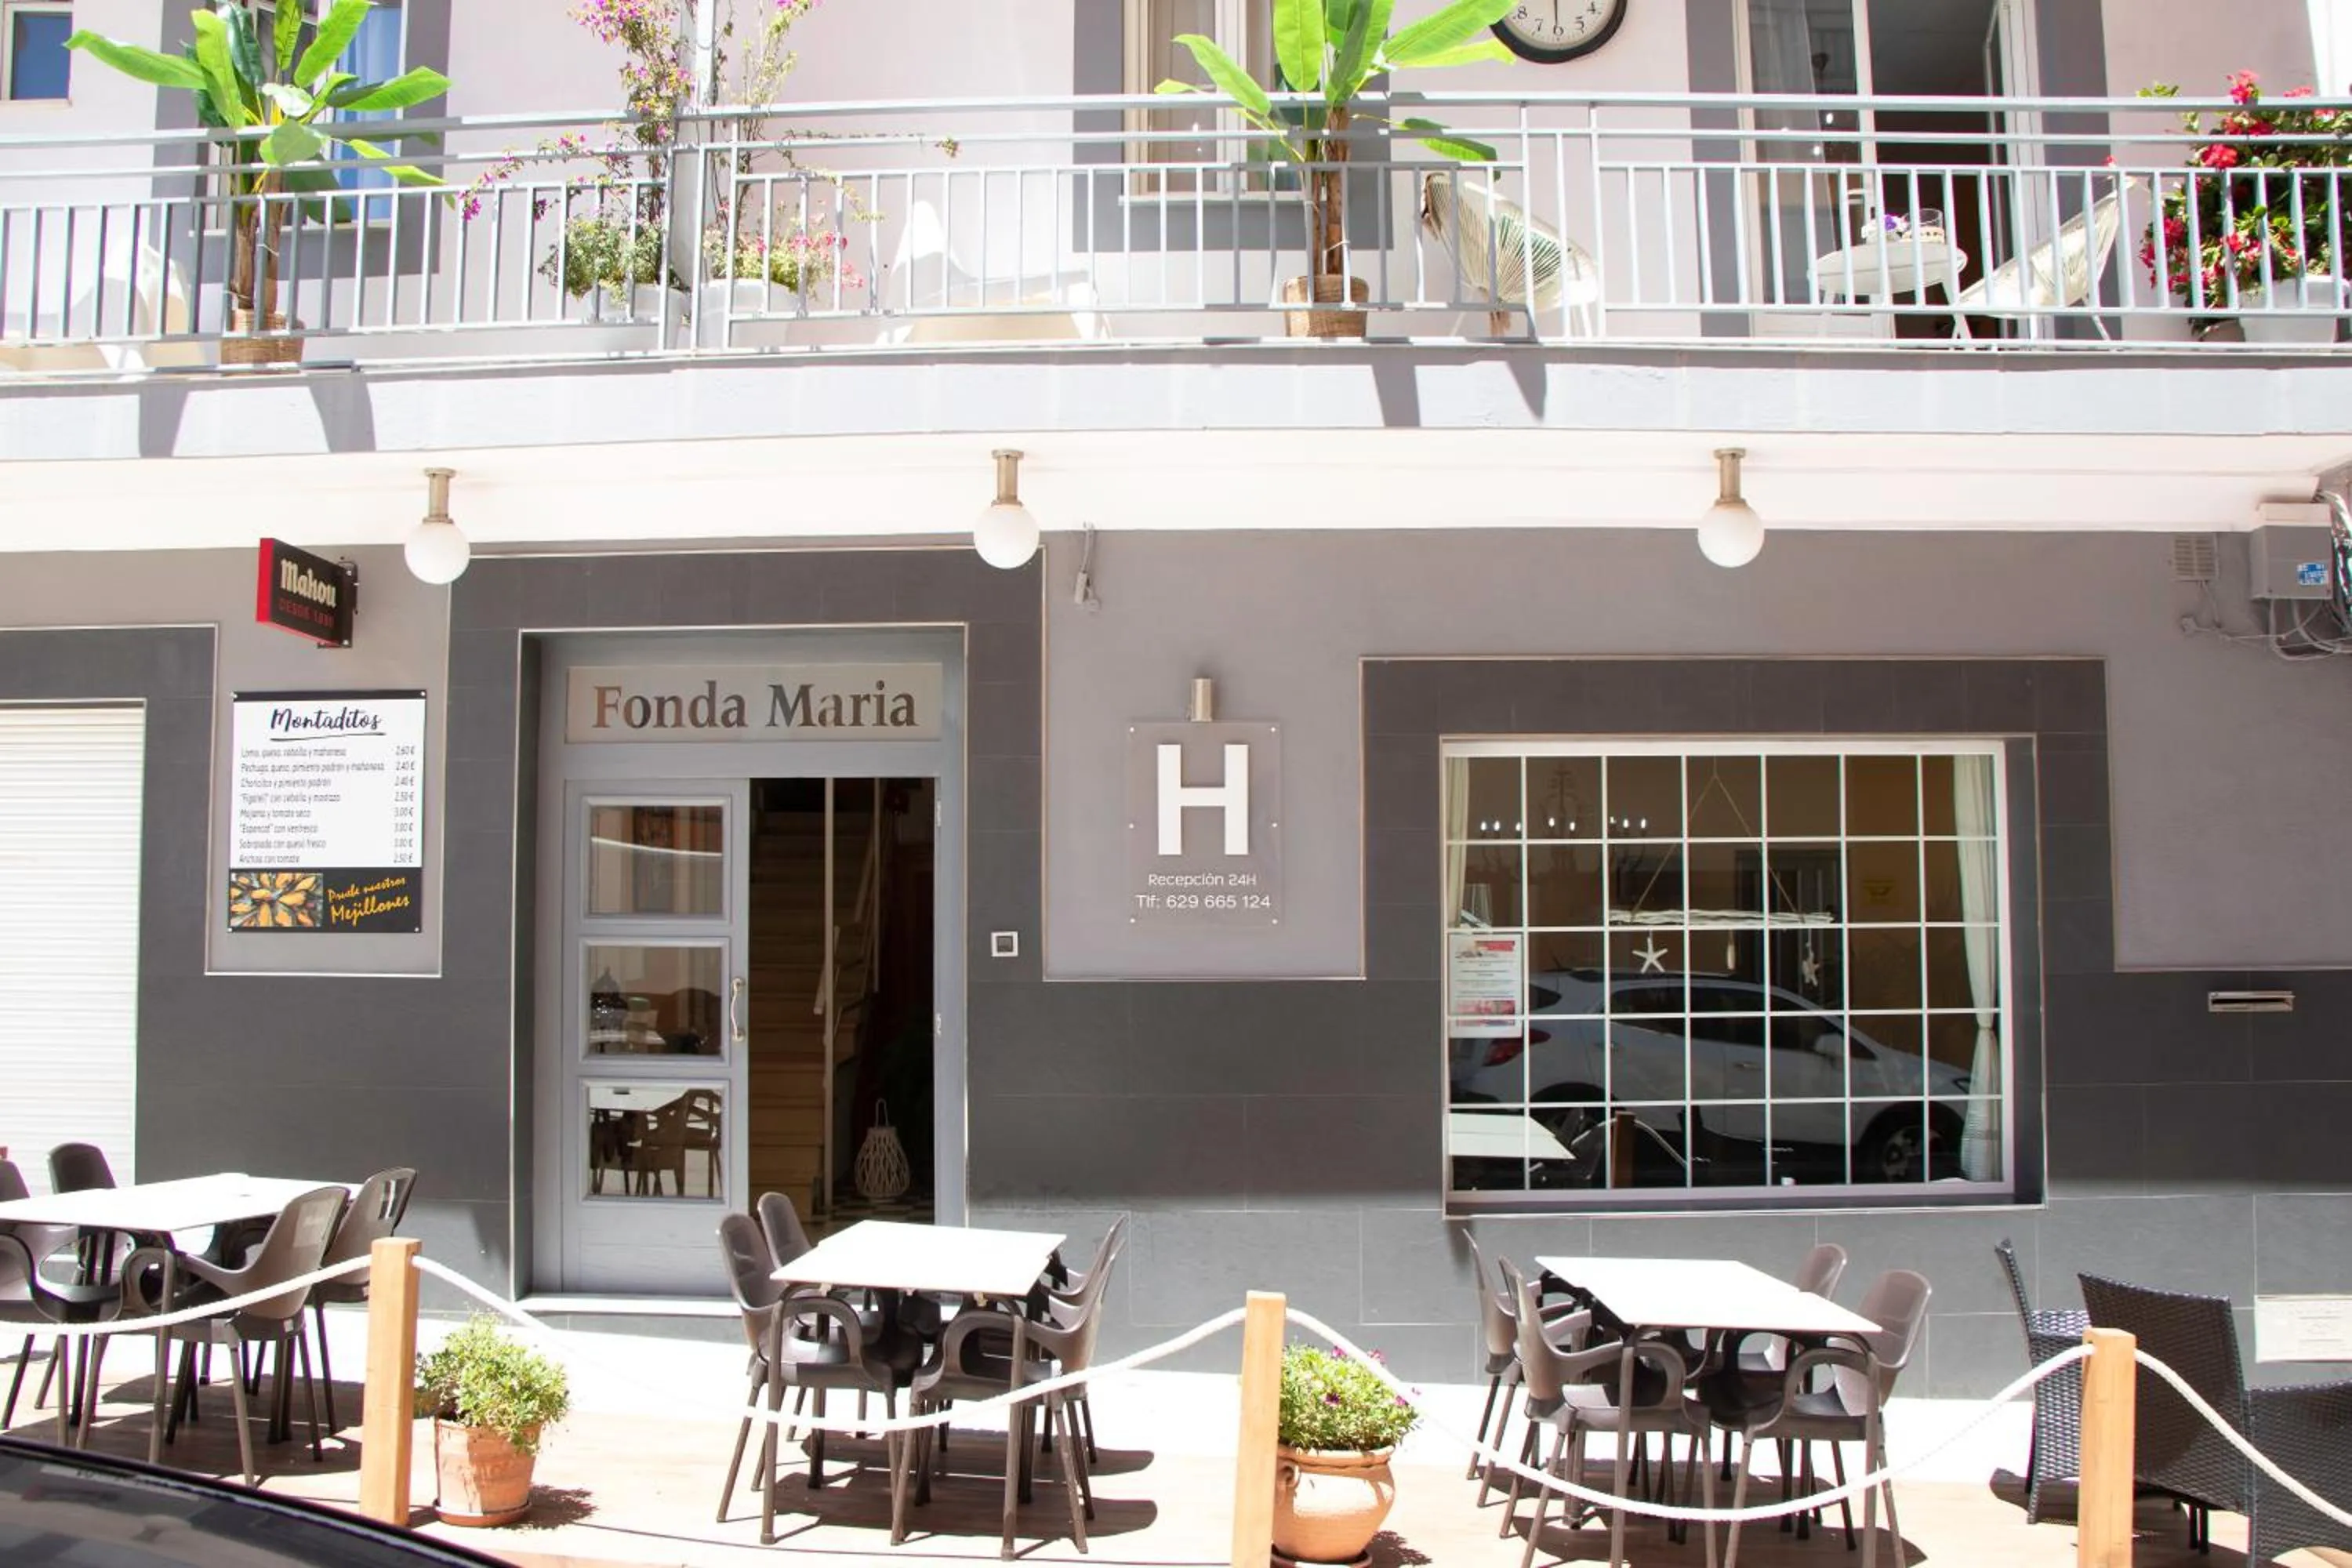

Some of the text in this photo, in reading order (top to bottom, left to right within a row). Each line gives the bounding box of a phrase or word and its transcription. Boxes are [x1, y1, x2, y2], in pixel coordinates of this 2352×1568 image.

[1517, 5, 1528, 20] 8
[1534, 18, 1544, 32] 7
[281, 558, 336, 608] Mahou
[592, 680, 920, 728] Fonda Maria
[270, 706, 382, 732] Montaditos
[1157, 744, 1250, 855] H
[1148, 873, 1258, 887] Recepción 24H
[331, 895, 410, 927] Mejillones
[1167, 895, 1199, 909] 629
[1204, 895, 1237, 909] 665
[1242, 895, 1271, 909] 124
